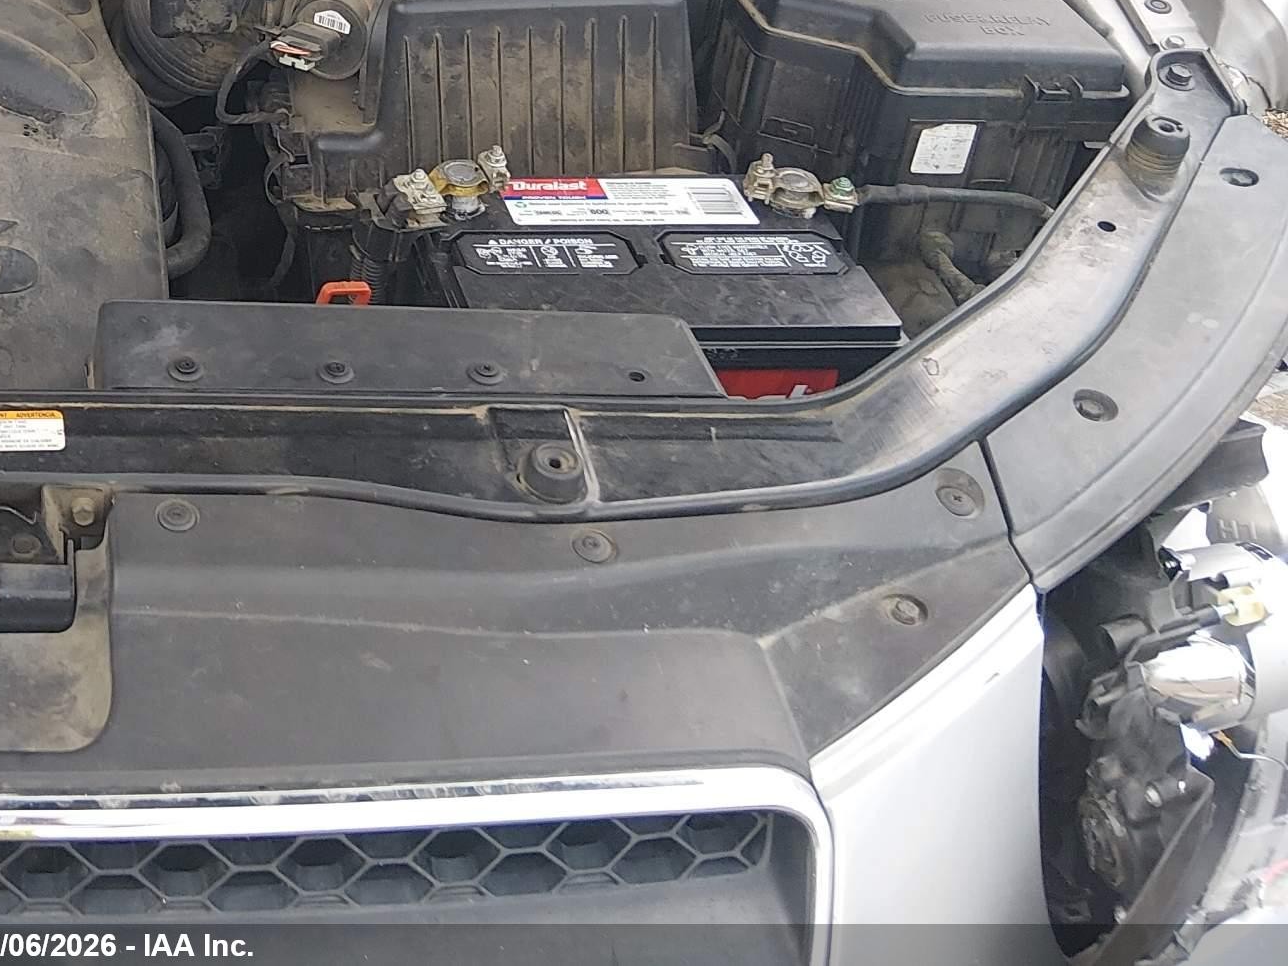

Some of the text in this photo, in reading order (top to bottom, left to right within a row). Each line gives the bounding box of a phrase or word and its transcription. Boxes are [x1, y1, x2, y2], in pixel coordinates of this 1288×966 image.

[510, 179, 588, 192] Duralast
[498, 237, 543, 246] DANGER
[553, 237, 593, 245] POISON
